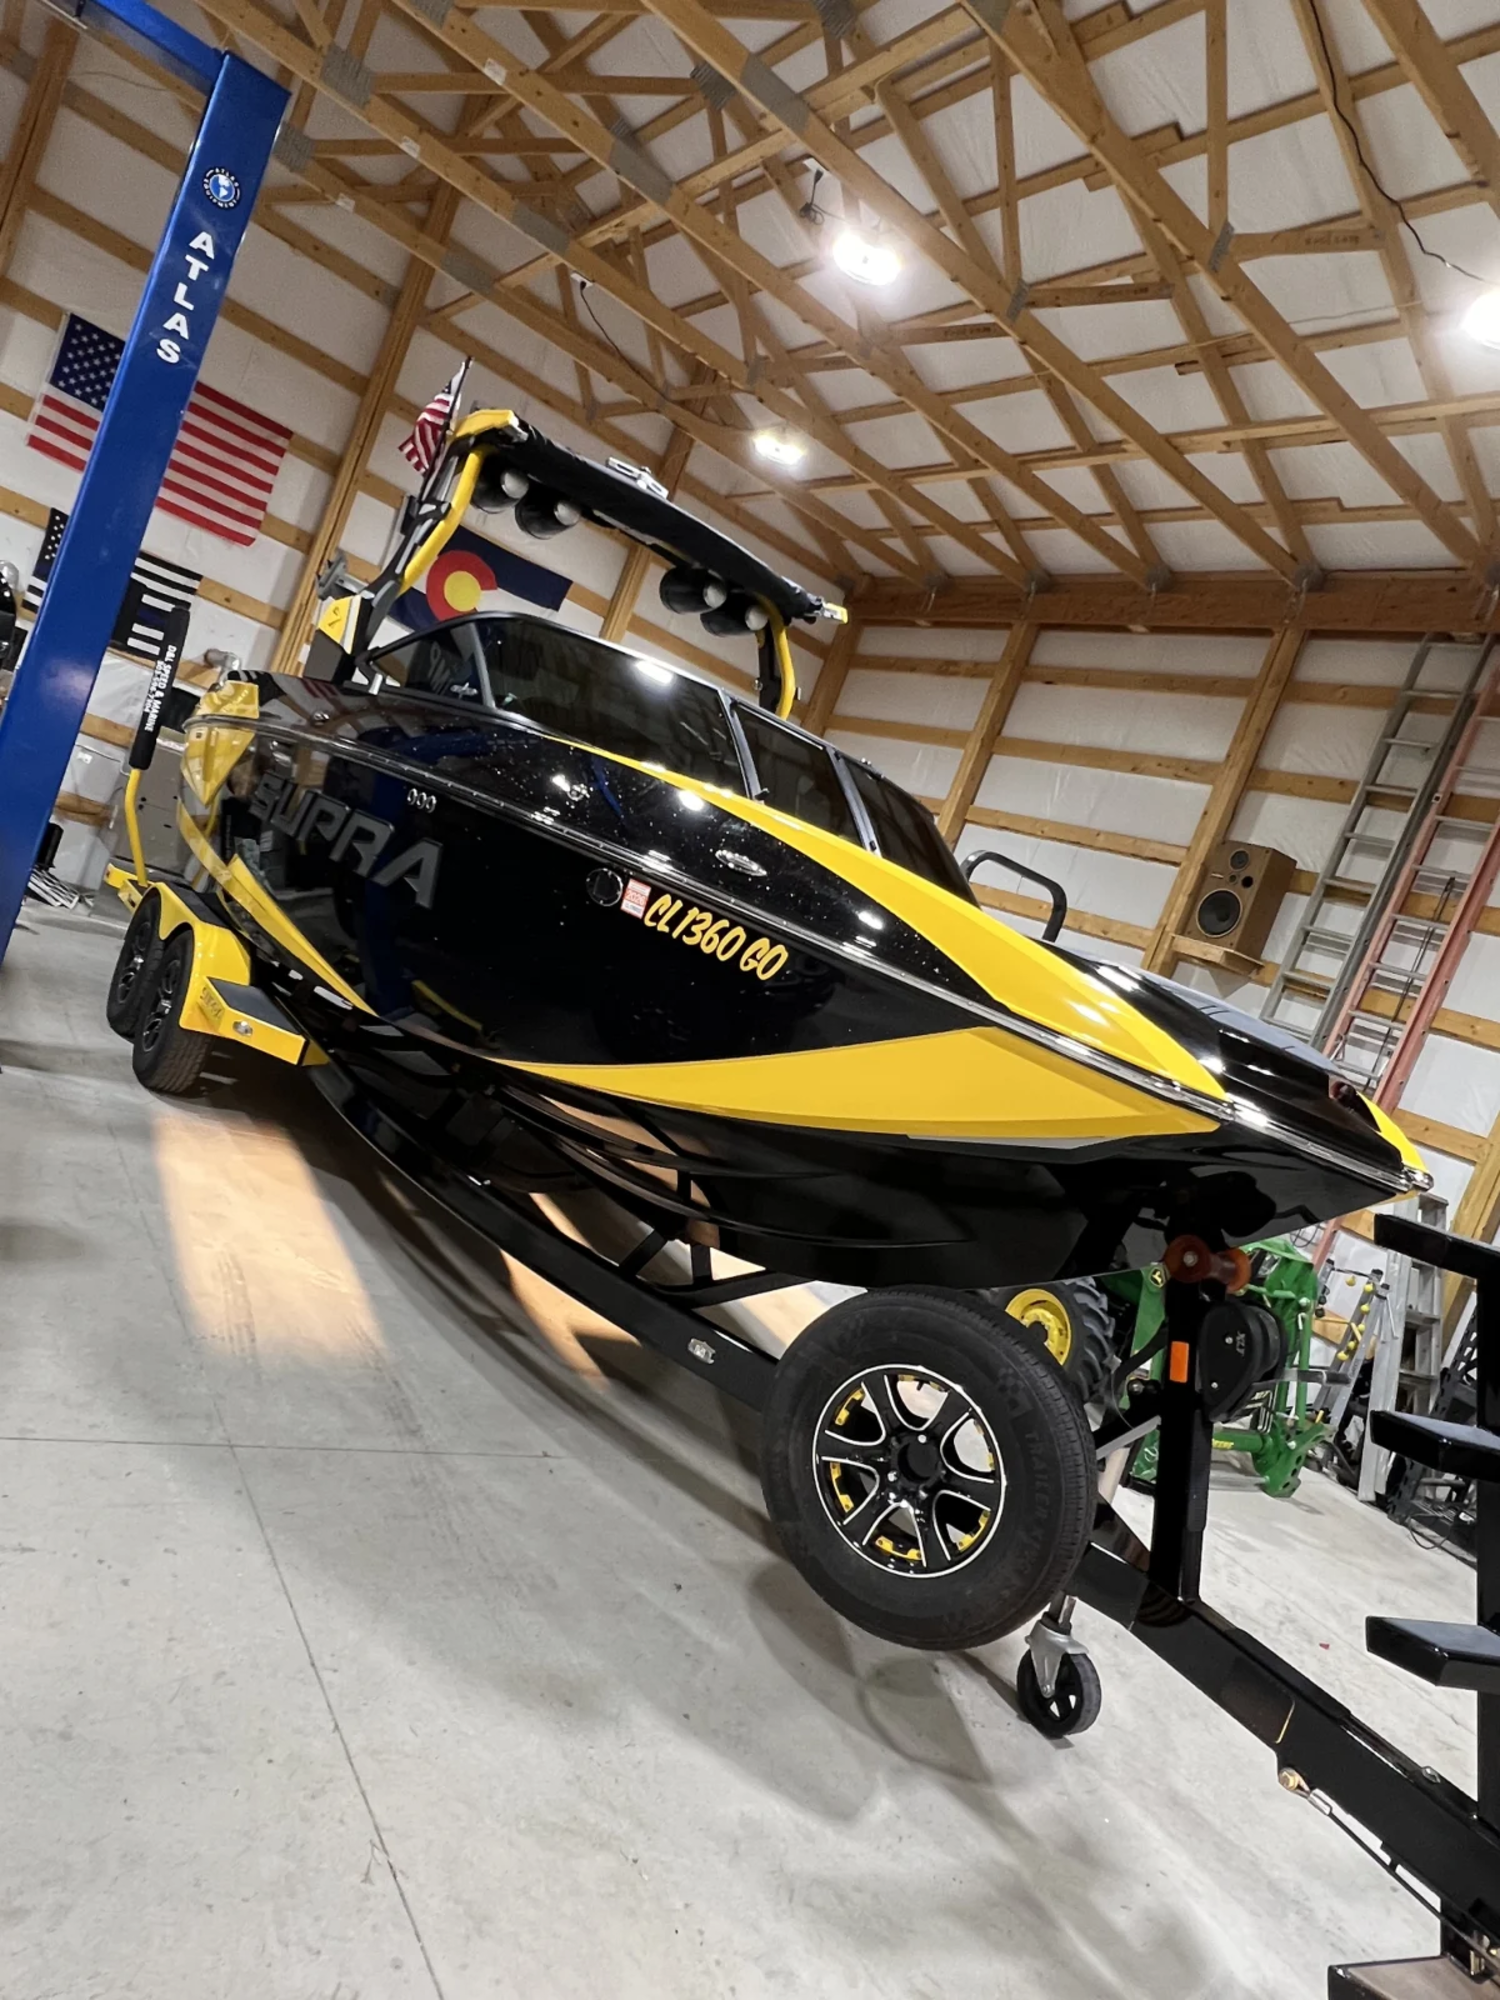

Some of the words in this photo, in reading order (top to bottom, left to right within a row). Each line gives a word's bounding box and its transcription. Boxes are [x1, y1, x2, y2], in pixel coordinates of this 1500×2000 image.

[156, 231, 215, 364] ATLAS
[158, 664, 172, 690] SPEED
[144, 699, 162, 732] MARINE
[249, 770, 443, 910] SUPRA
[672, 907, 747, 962] 1360
[740, 917, 789, 981] GO
